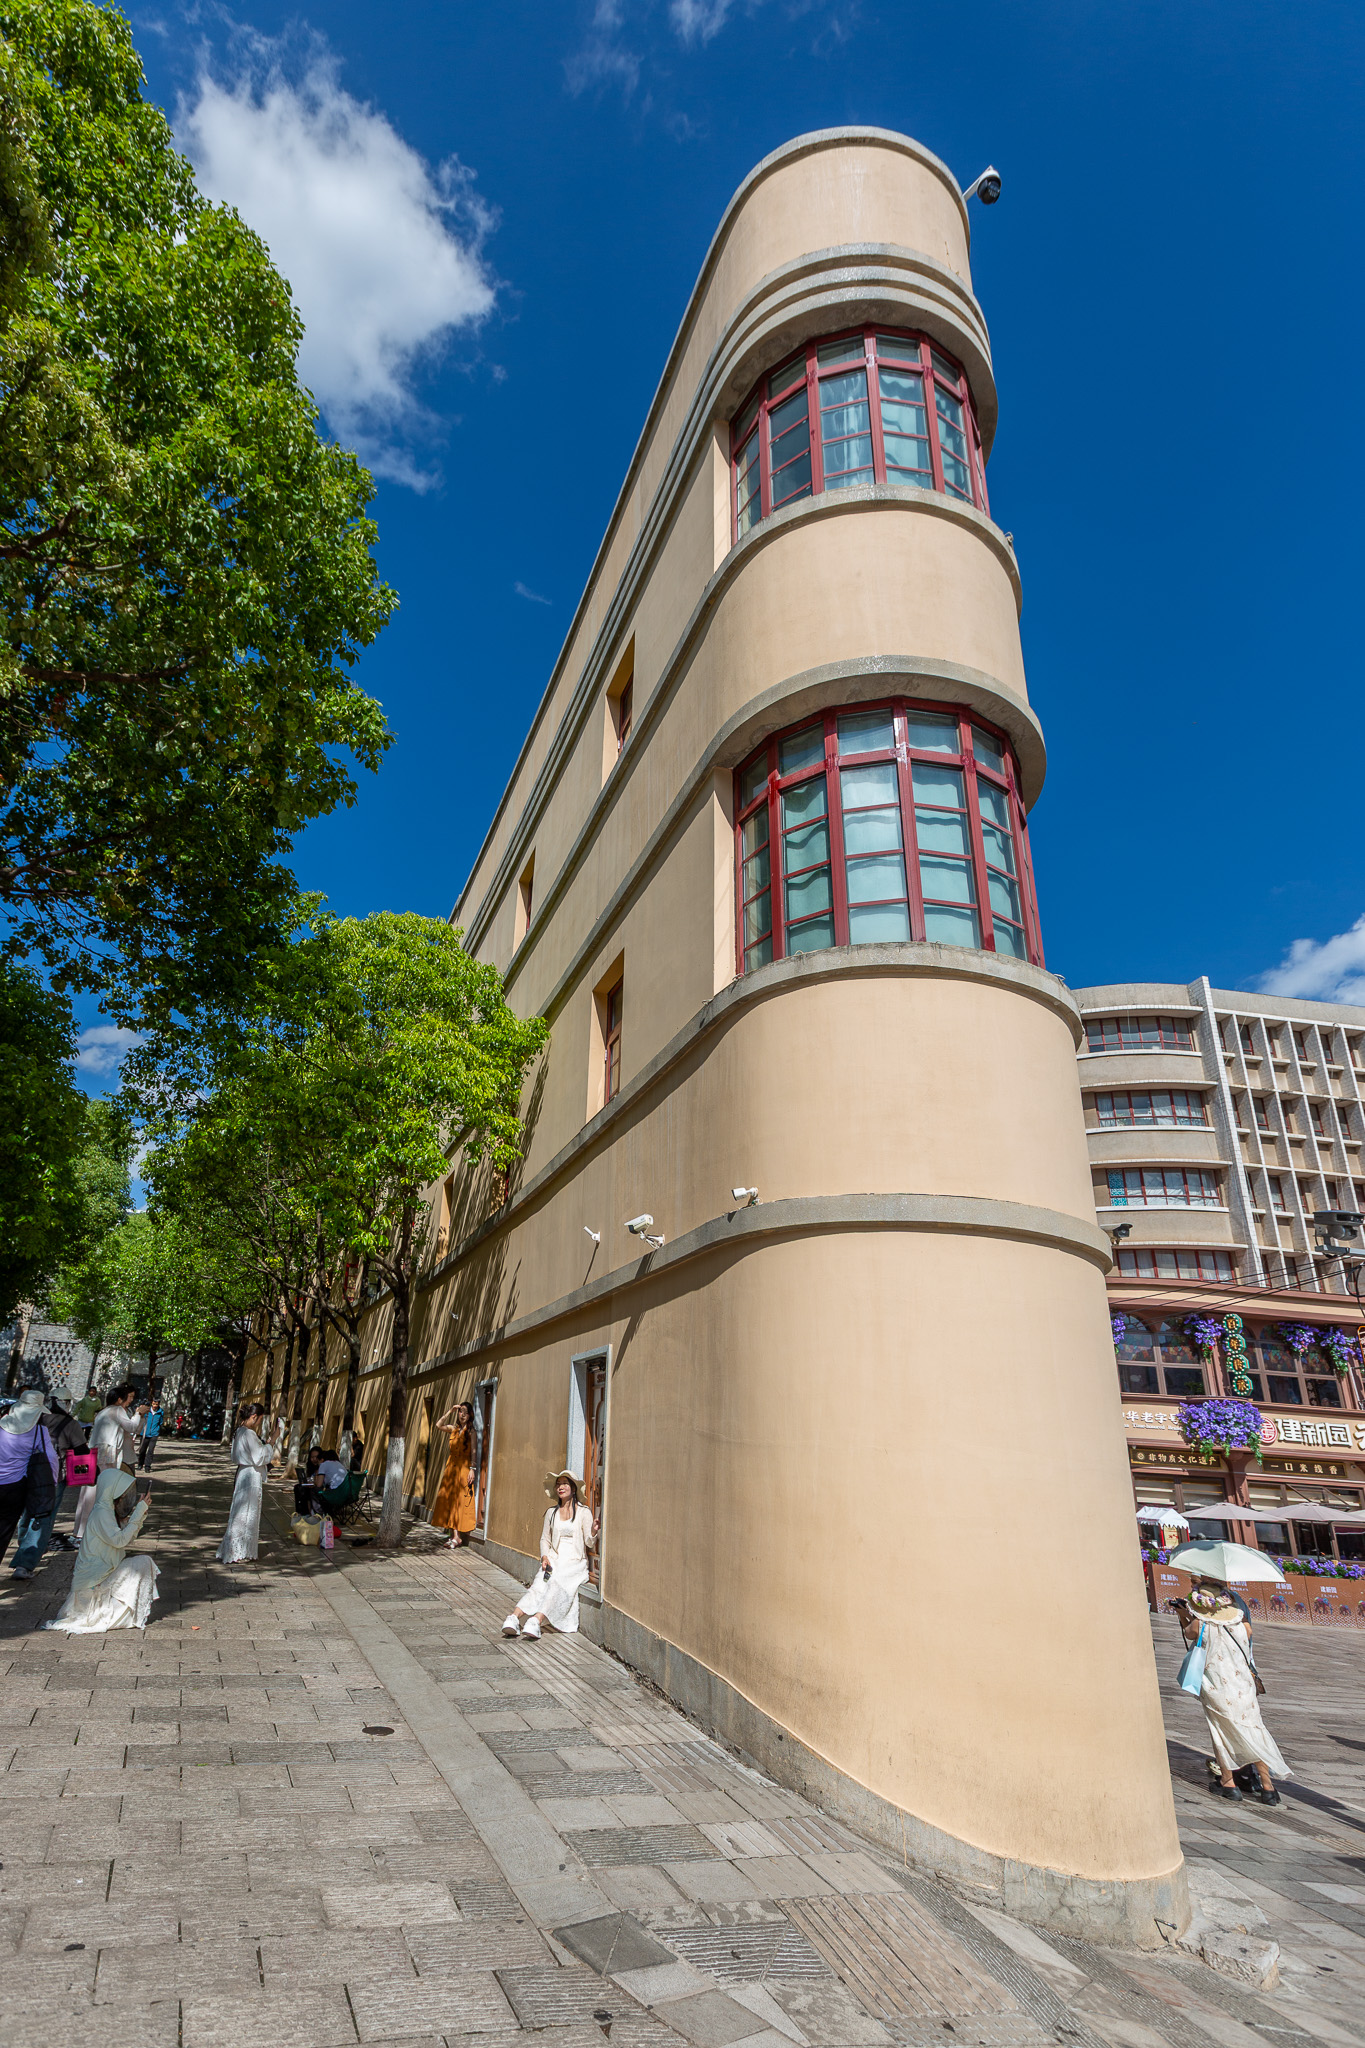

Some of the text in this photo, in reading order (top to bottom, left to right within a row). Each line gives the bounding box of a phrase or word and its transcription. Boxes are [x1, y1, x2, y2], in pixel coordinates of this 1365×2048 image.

[1274, 1418, 1353, 1447] 建新园
[1148, 1453, 1216, 1465] 非物质文化遗产
[1271, 1463, 1337, 1474] 一口米线香
